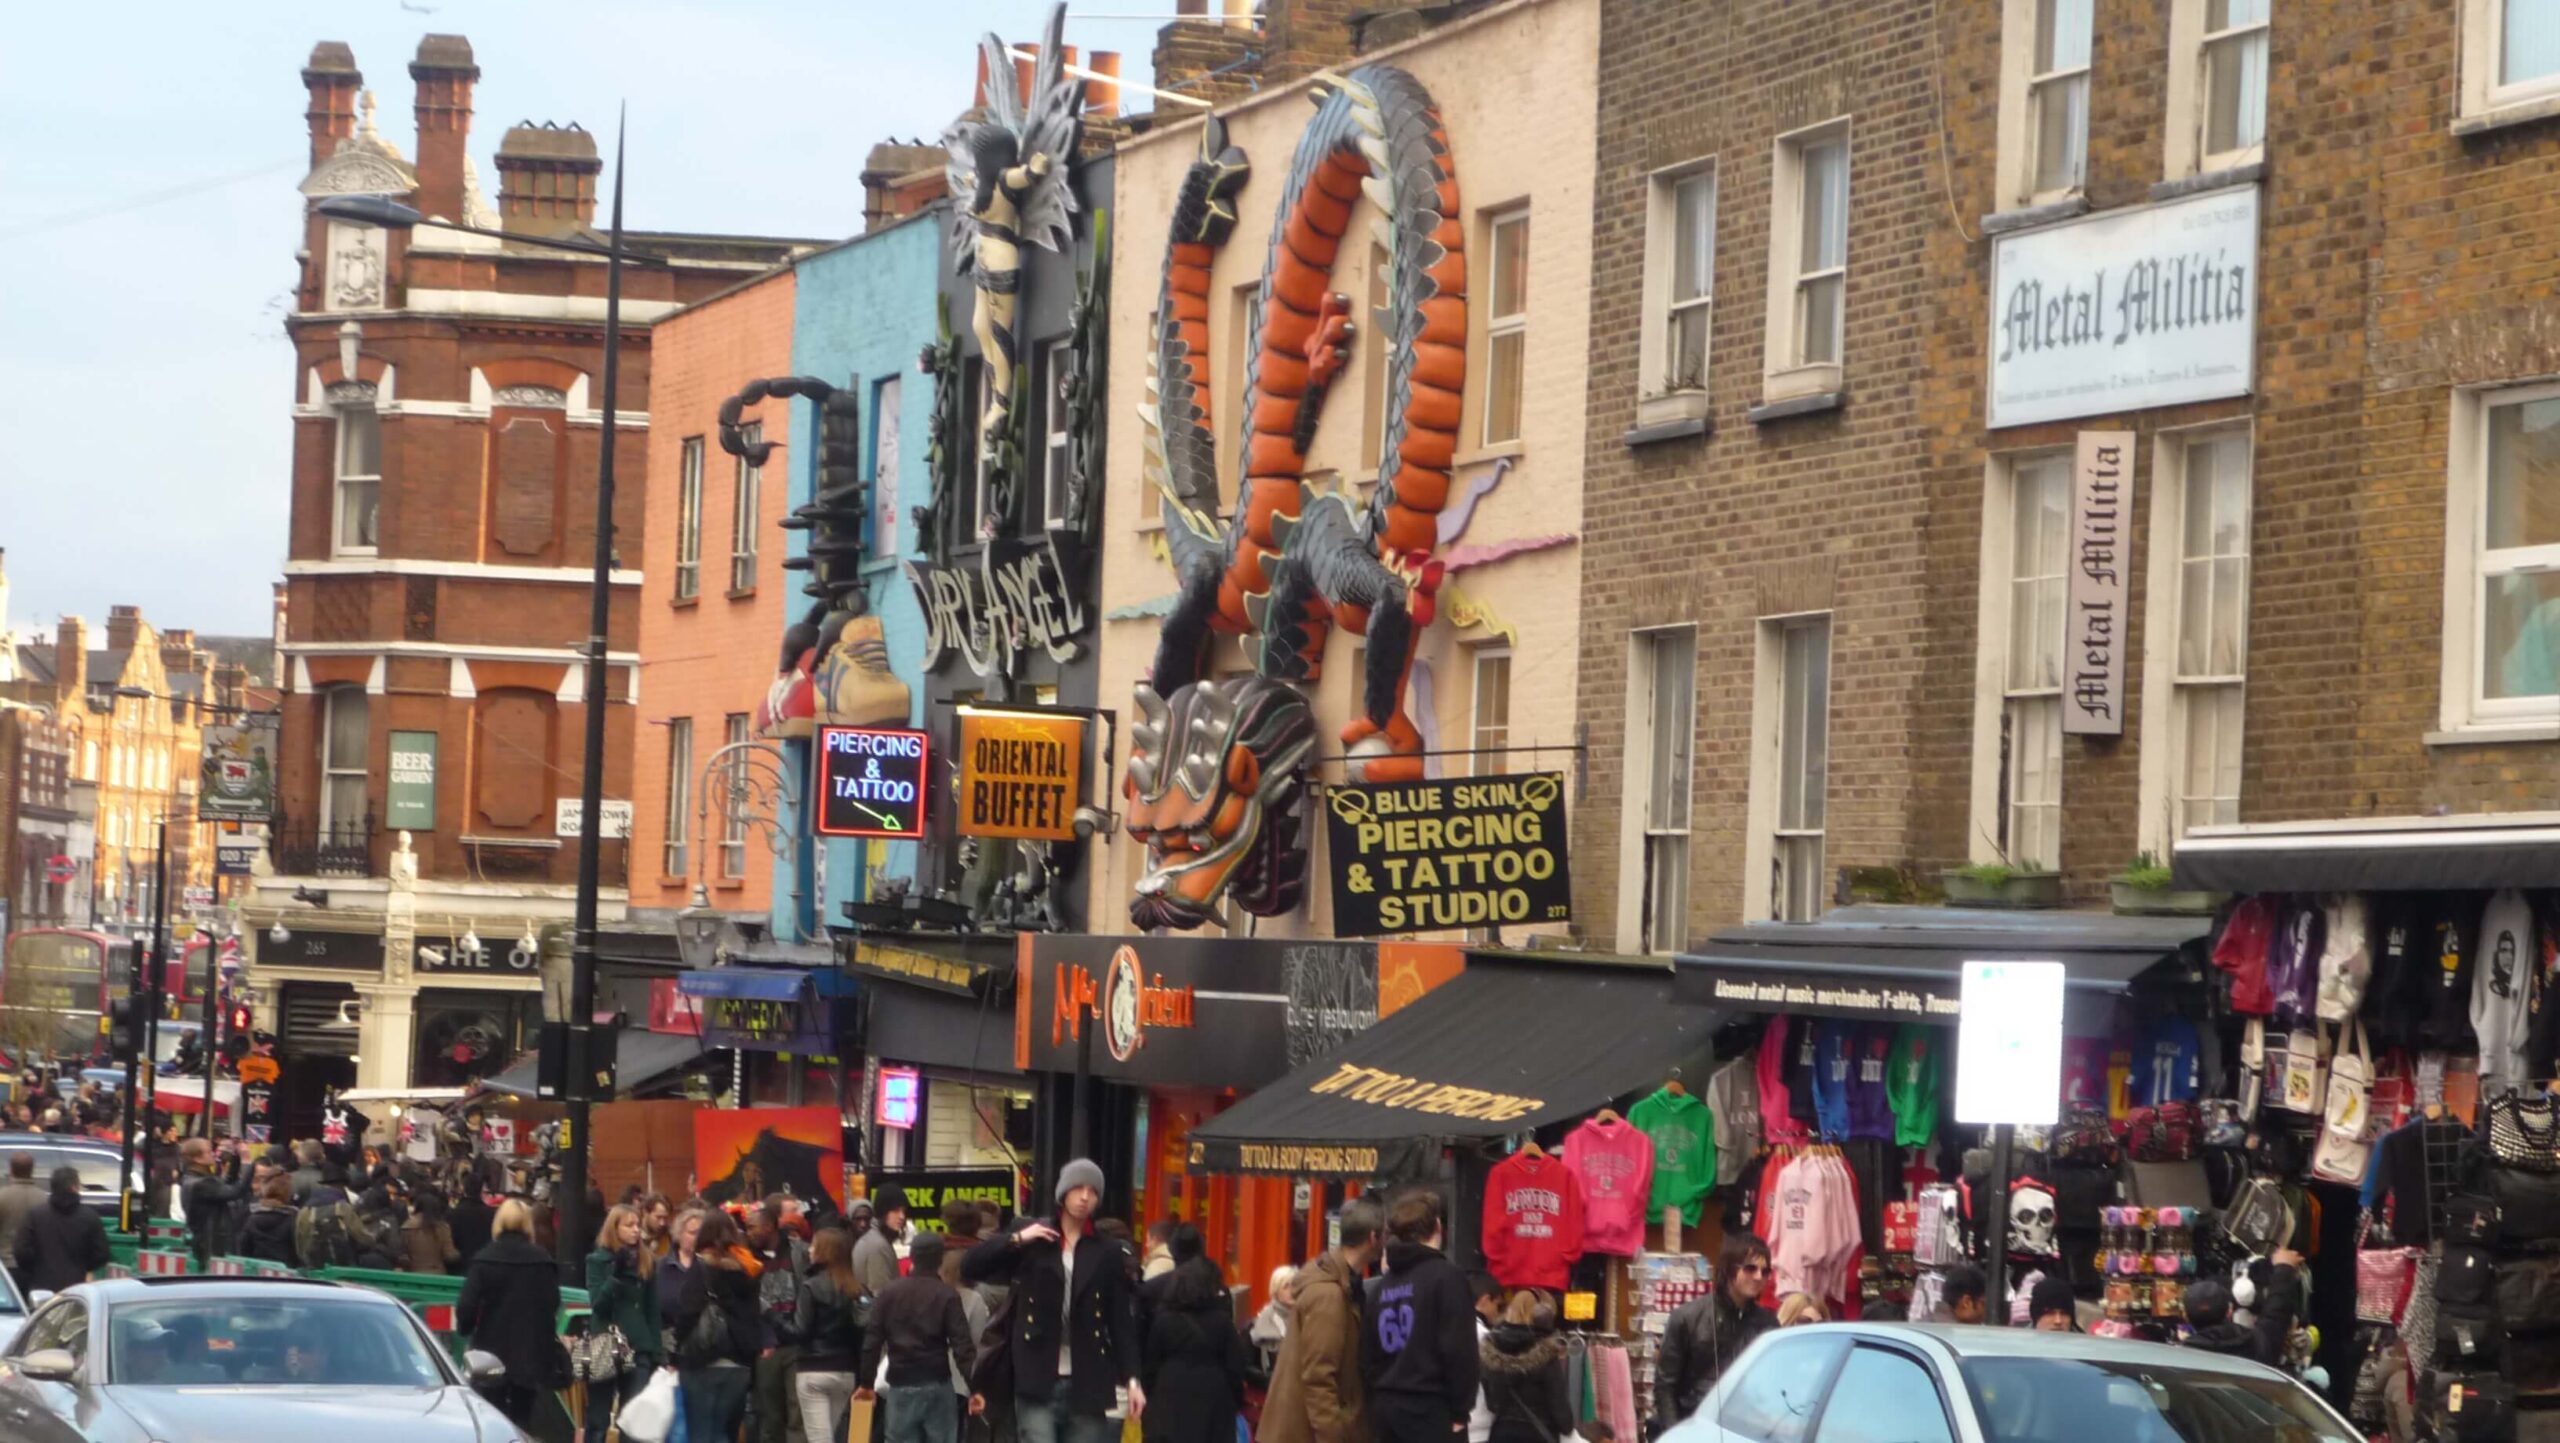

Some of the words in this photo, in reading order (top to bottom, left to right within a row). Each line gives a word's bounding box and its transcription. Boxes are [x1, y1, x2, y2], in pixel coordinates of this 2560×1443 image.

[1999, 268, 2105, 365] Metal
[2113, 248, 2246, 349] Militia
[2081, 445, 2121, 586] Militia
[2074, 600, 2113, 720] Metal
[392, 752, 434, 770] BEER
[826, 732, 921, 757] PIERCING
[974, 738, 1067, 778] ORIENTAL
[833, 776, 914, 802] TATTOO
[865, 759, 882, 779] &
[972, 780, 1067, 829] BUFFET
[1375, 787, 1443, 814] BLUE
[1453, 783, 1517, 809] SKIN
[1358, 811, 1542, 854] PIERCING
[1347, 863, 1375, 894] &
[1382, 847, 1555, 890] TATTOO
[1379, 888, 1530, 929] STUDIO
[305, 941, 327, 956] 265
[429, 945, 491, 968] THE
[1310, 1062, 1417, 1104] TATTOO
[1403, 1084, 1545, 1122] PIERCING
[1240, 1144, 1271, 1168] TATTOO
[1280, 1145, 1301, 1169] BODY
[1302, 1146, 1343, 1171] PIERCING
[1343, 1147, 1378, 1172] STUDIO
[1505, 1187, 1561, 1216] LONDON
[1378, 1304, 1415, 1352] 69
